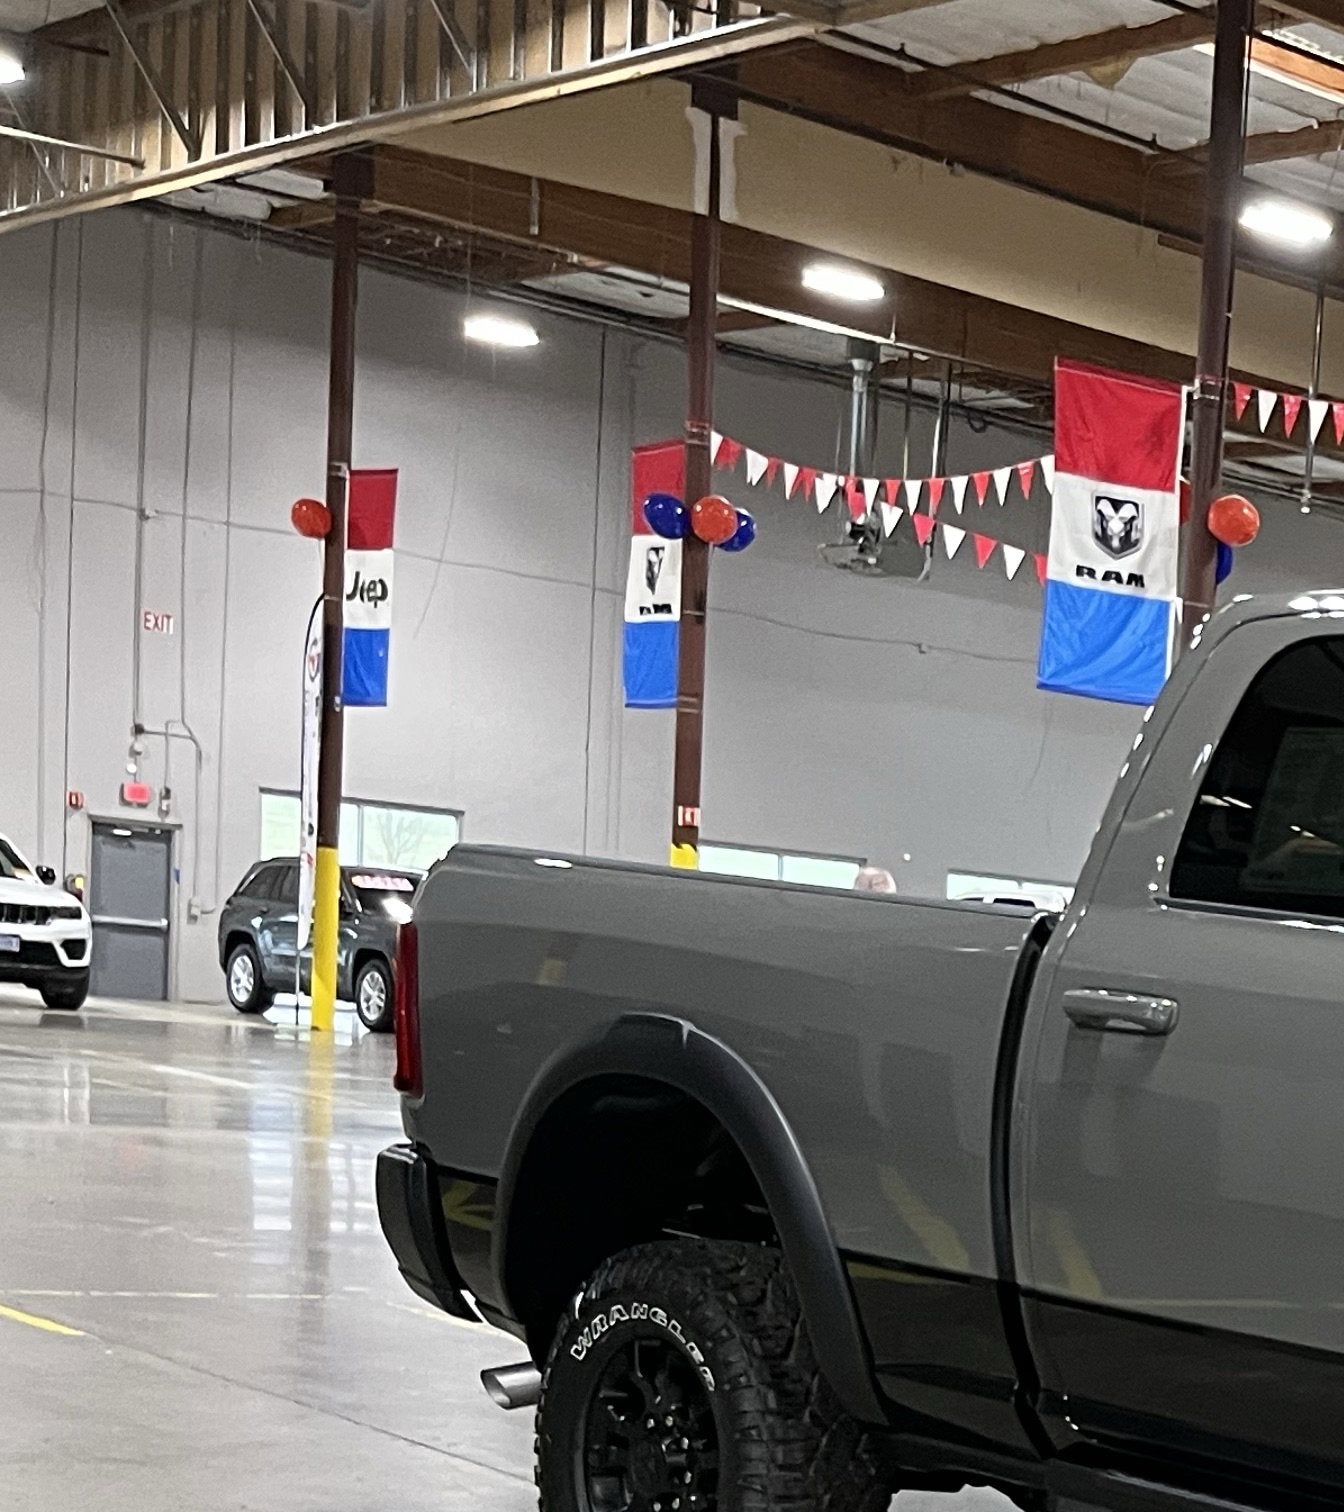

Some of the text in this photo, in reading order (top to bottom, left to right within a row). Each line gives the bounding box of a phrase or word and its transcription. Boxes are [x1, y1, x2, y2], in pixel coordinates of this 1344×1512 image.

[1075, 564, 1145, 588] RAM
[143, 611, 172, 632] EXIT
[570, 1302, 715, 1391] WRANGLER
